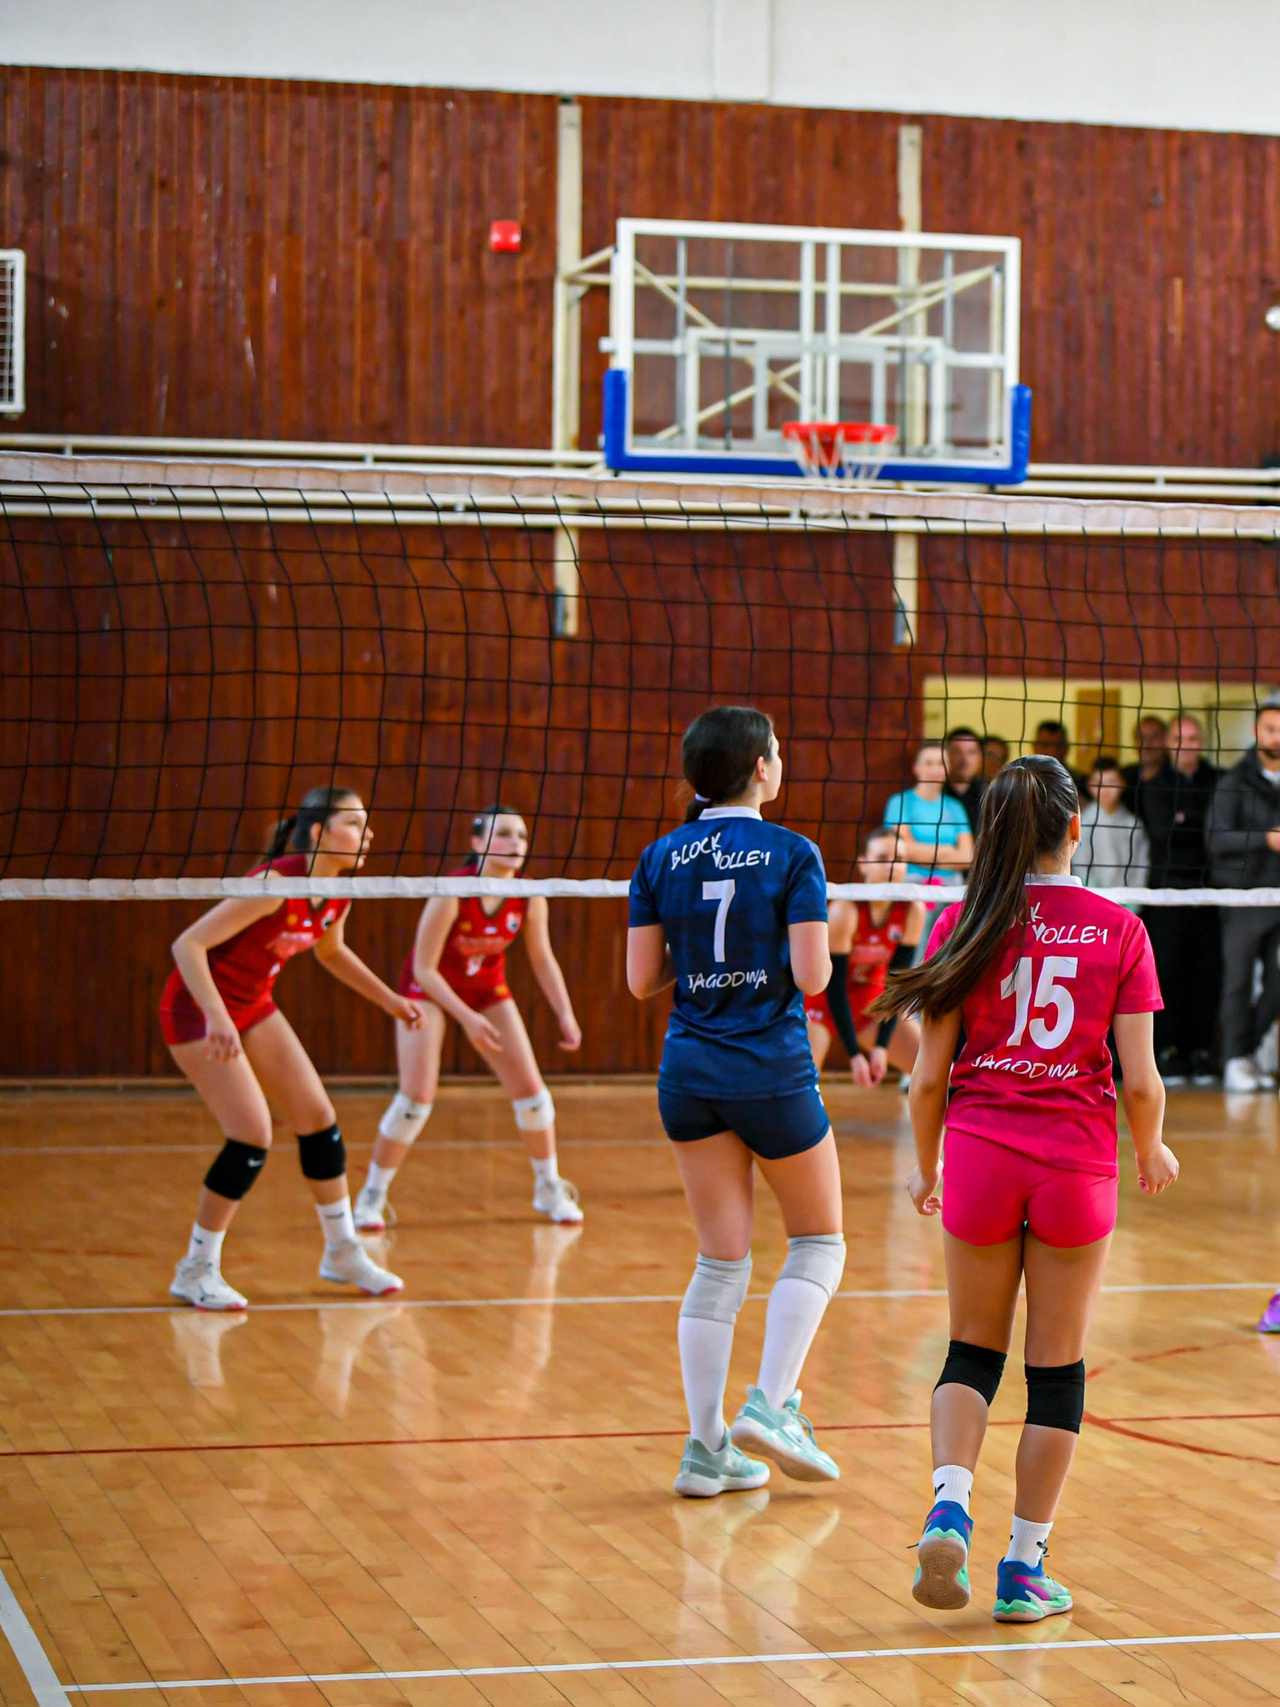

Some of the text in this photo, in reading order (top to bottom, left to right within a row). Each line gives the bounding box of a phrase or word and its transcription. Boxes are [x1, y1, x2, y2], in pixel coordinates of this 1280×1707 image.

[671, 832, 771, 870] BLOCK VOLLEY
[702, 879, 736, 963] 7
[1031, 922, 1108, 945] VOLLEY
[687, 969, 768, 994] JAGODINA
[1000, 955, 1079, 1050] 15
[970, 1053, 1079, 1081] JAGODINA
